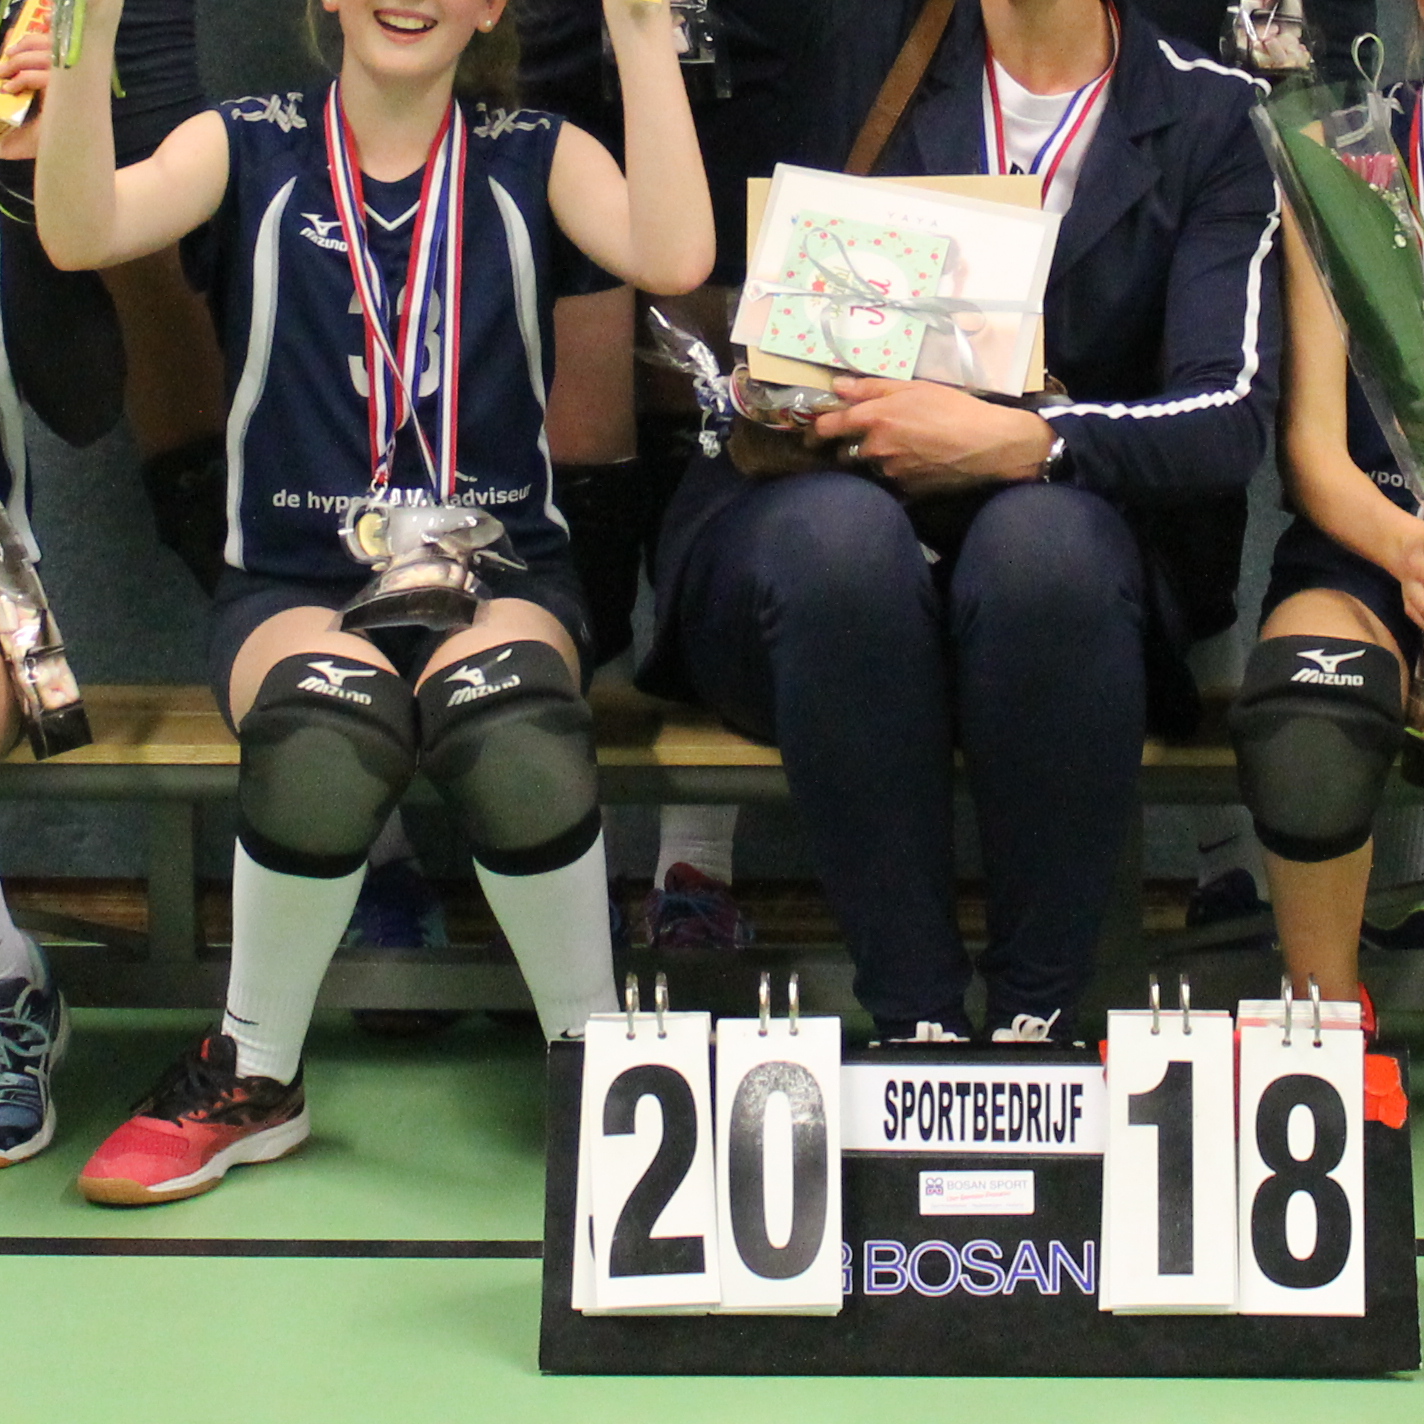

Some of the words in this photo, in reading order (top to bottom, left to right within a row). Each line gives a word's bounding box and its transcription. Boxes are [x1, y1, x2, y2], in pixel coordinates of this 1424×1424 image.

[273, 490, 300, 508] de
[883, 1076, 1084, 1144] SPORTBEDRIJF
[947, 1180, 986, 1191] BOSAN
[990, 1179, 1029, 1190] SPORT
[863, 1239, 1096, 1296] BOSAN
